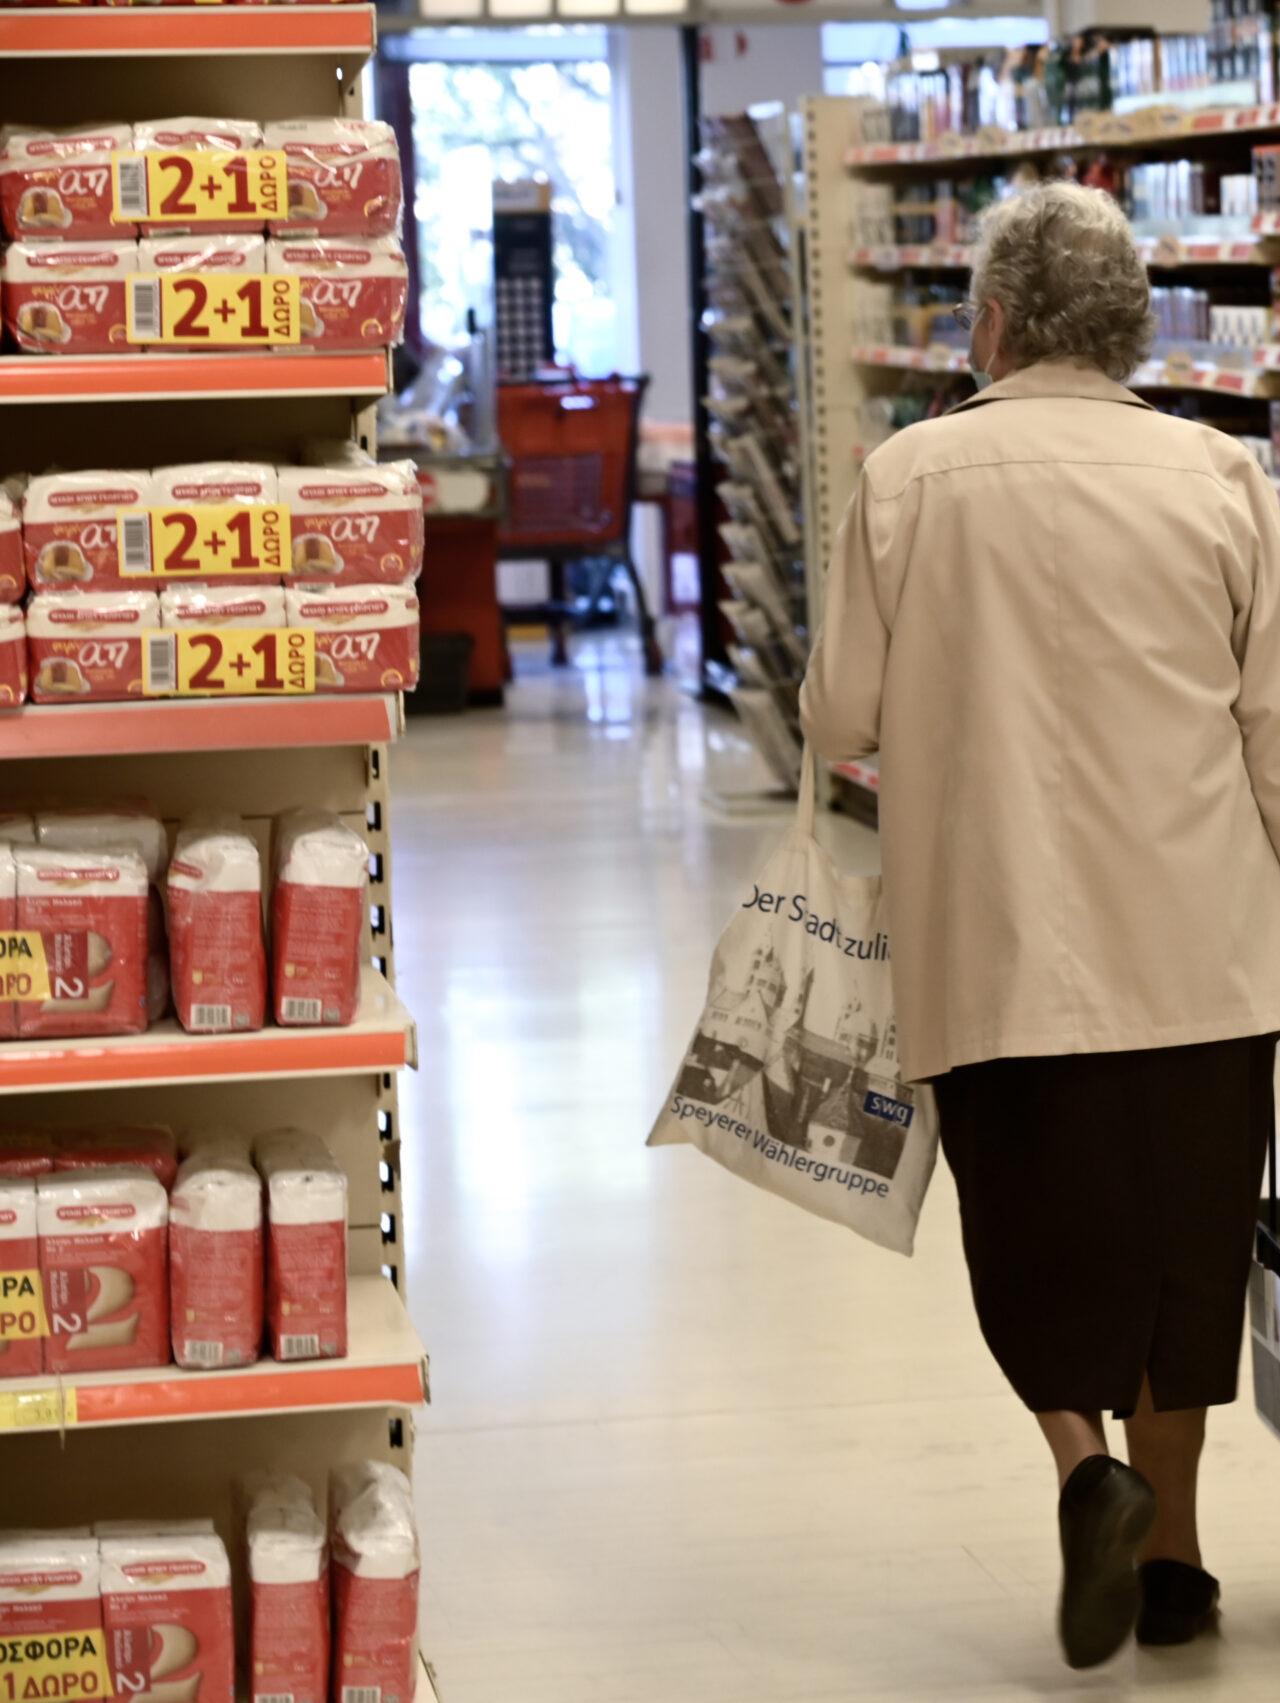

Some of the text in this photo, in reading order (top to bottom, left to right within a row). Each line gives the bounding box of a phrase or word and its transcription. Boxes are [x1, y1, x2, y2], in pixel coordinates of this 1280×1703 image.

[158, 155, 278, 215] 2+1 ΔΩΡΟ
[172, 278, 291, 338] 2+1 ΔΩΡΟ
[162, 510, 282, 570] 2+1 ΔΩΡΟ
[188, 632, 306, 690] 2+1 ΔΩΡΟ
[844, 932, 891, 962] zuli
[870, 1096, 908, 1124] swg
[671, 1096, 889, 1198] Speyerer Wählergruppe
[0, 1635, 97, 1664] ΣΦΟΡΑ
[22, 1671, 98, 1700] ΔΩΡΟ
